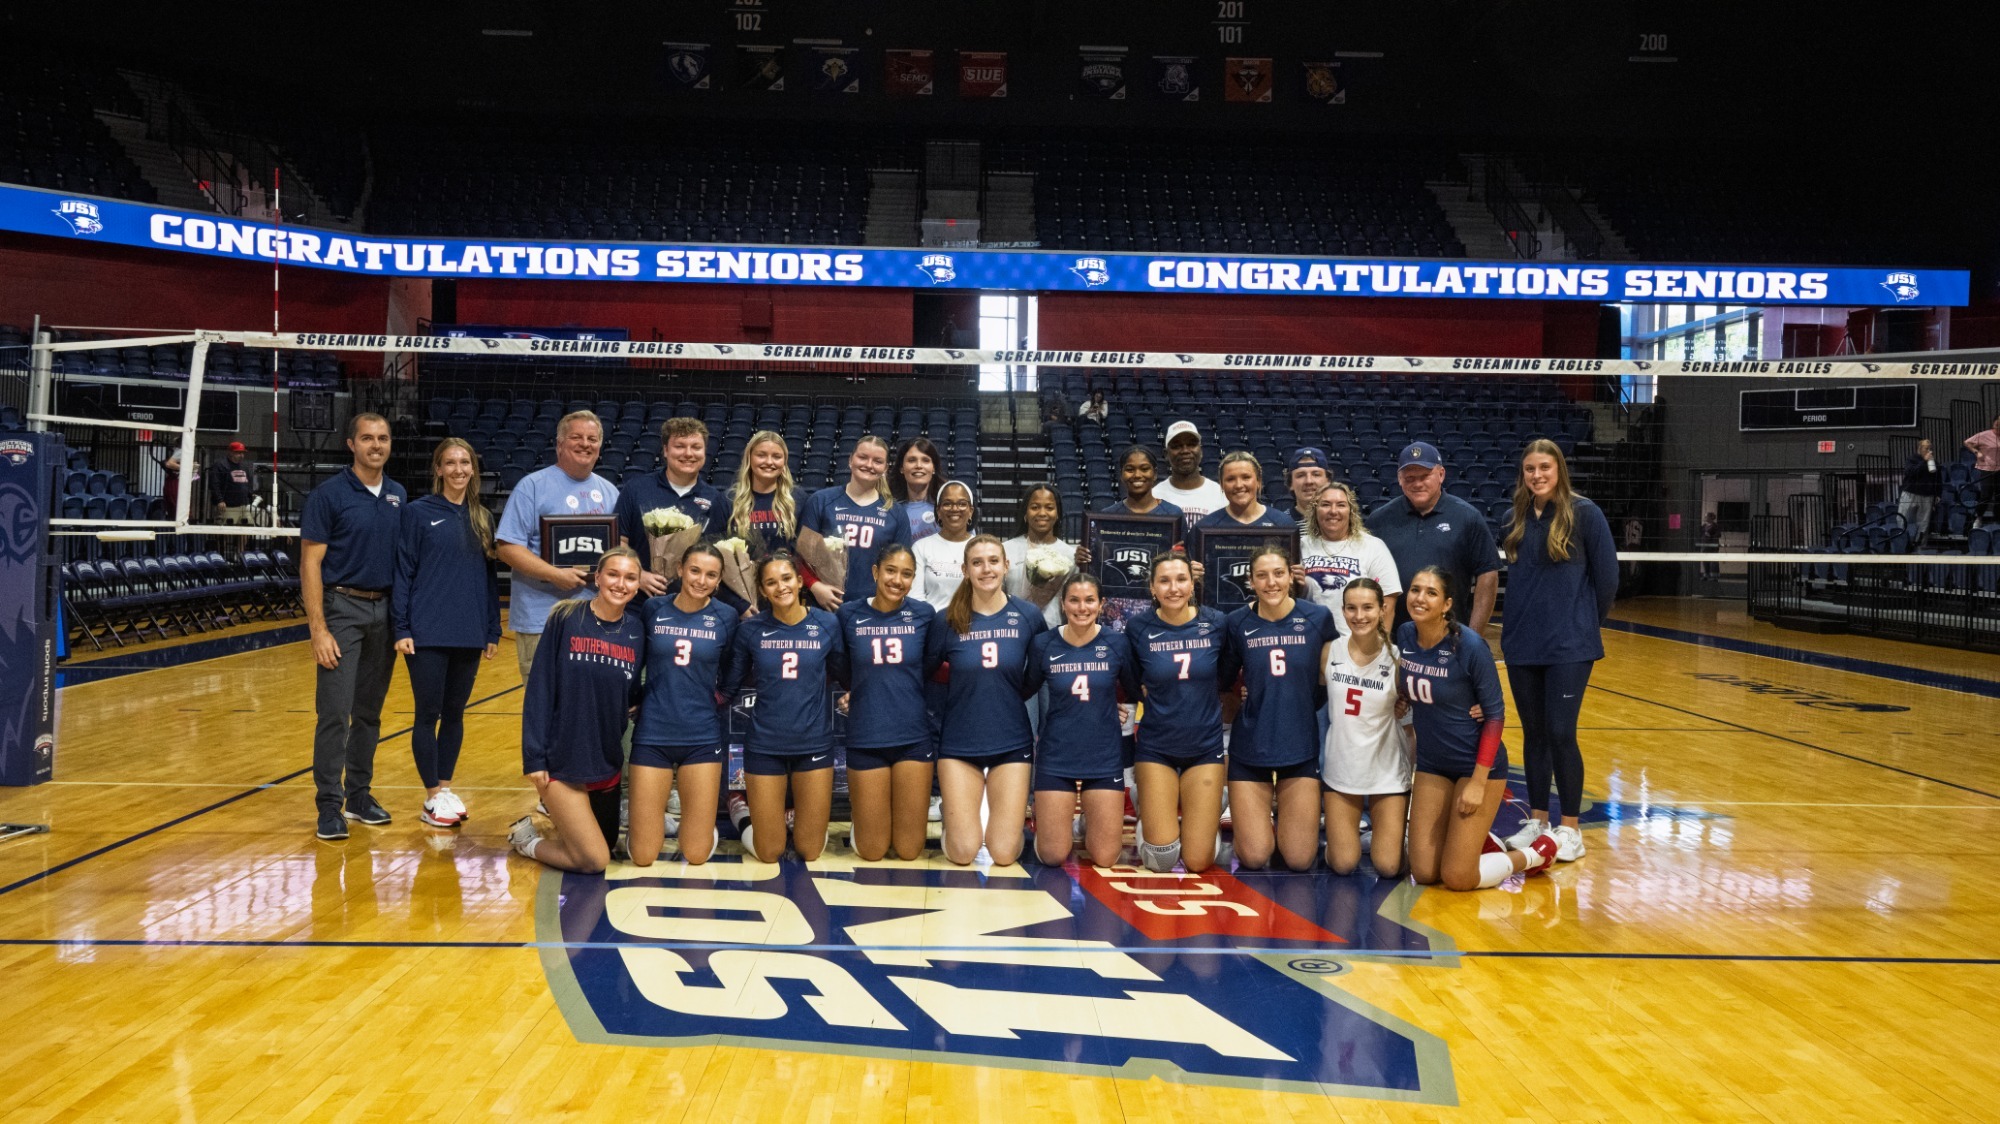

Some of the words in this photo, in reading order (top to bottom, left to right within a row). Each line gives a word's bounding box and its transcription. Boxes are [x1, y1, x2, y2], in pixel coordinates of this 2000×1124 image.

[1218, 1, 1244, 19] 201
[736, 13, 762, 31] 102
[1218, 26, 1242, 44] 101
[1639, 34, 1668, 51] 200
[61, 201, 98, 218] USI
[150, 213, 640, 277] CONGRATULATIONS
[656, 250, 863, 281] SENIORS
[922, 255, 953, 268] USI
[1076, 258, 1105, 271] USI
[1147, 260, 1609, 296] CONGRATULATIONS
[1624, 269, 1828, 300] SENIORS
[1887, 272, 1917, 287] USI
[296, 333, 387, 347] SCREAMING
[395, 336, 451, 349] EAGLES
[530, 340, 621, 353] SCREAMING
[628, 342, 684, 355] EAGLES
[763, 345, 853, 358] SCREAMING
[860, 347, 916, 360] EAGLES
[994, 350, 1083, 363] SCREAMING
[1090, 352, 1145, 364] EAGLES
[1224, 354, 1312, 367] SCREAMING
[1319, 356, 1375, 368] EAGLES
[1452, 358, 1542, 371] SCREAMING
[1548, 359, 1604, 371] EAGLES
[1681, 361, 1770, 374] SCREAMING
[1776, 362, 1832, 374] EAGLES
[1910, 362, 1999, 375] SCREAMING
[835, 513, 864, 523] SOUTHERN
[864, 516, 886, 527] INDIANA
[845, 523, 874, 549] 20
[558, 536, 604, 555] USI
[1116, 550, 1149, 564] USI
[654, 625, 688, 637] SOUTHERN
[689, 628, 717, 641] INDIANA
[856, 626, 889, 636] SOUTHERN
[890, 625, 916, 635] INDIANA
[959, 630, 992, 642] SOUTHERN
[993, 628, 1019, 639] INDIANA
[570, 636, 610, 656] SOUTHERN
[610, 643, 636, 664] INDIANA
[760, 639, 793, 650] SOUTHERN
[794, 639, 821, 650] INDIANA
[1149, 641, 1184, 652] SOUTHERN
[1185, 638, 1212, 650] INDIANA
[1246, 636, 1279, 649] SOUTHERN
[1280, 635, 1306, 645] INDIANA
[674, 639, 693, 667] 3
[871, 637, 904, 665] 13
[981, 641, 999, 669] 9
[569, 652, 635, 672] VOLLEYBALL
[781, 651, 799, 680] 2
[1050, 662, 1082, 674] SOUTHERN
[1083, 662, 1109, 672] INDIANA
[1173, 652, 1192, 680] 7
[1269, 648, 1287, 677] 6
[1424, 665, 1449, 678] INDIANA
[1071, 674, 1090, 702] 4
[1331, 672, 1360, 686] SOUTHERN
[1360, 677, 1384, 691] INDIANA
[1406, 675, 1434, 705] 10
[42, 677, 50, 722] imports
[1344, 687, 1364, 717] 5
